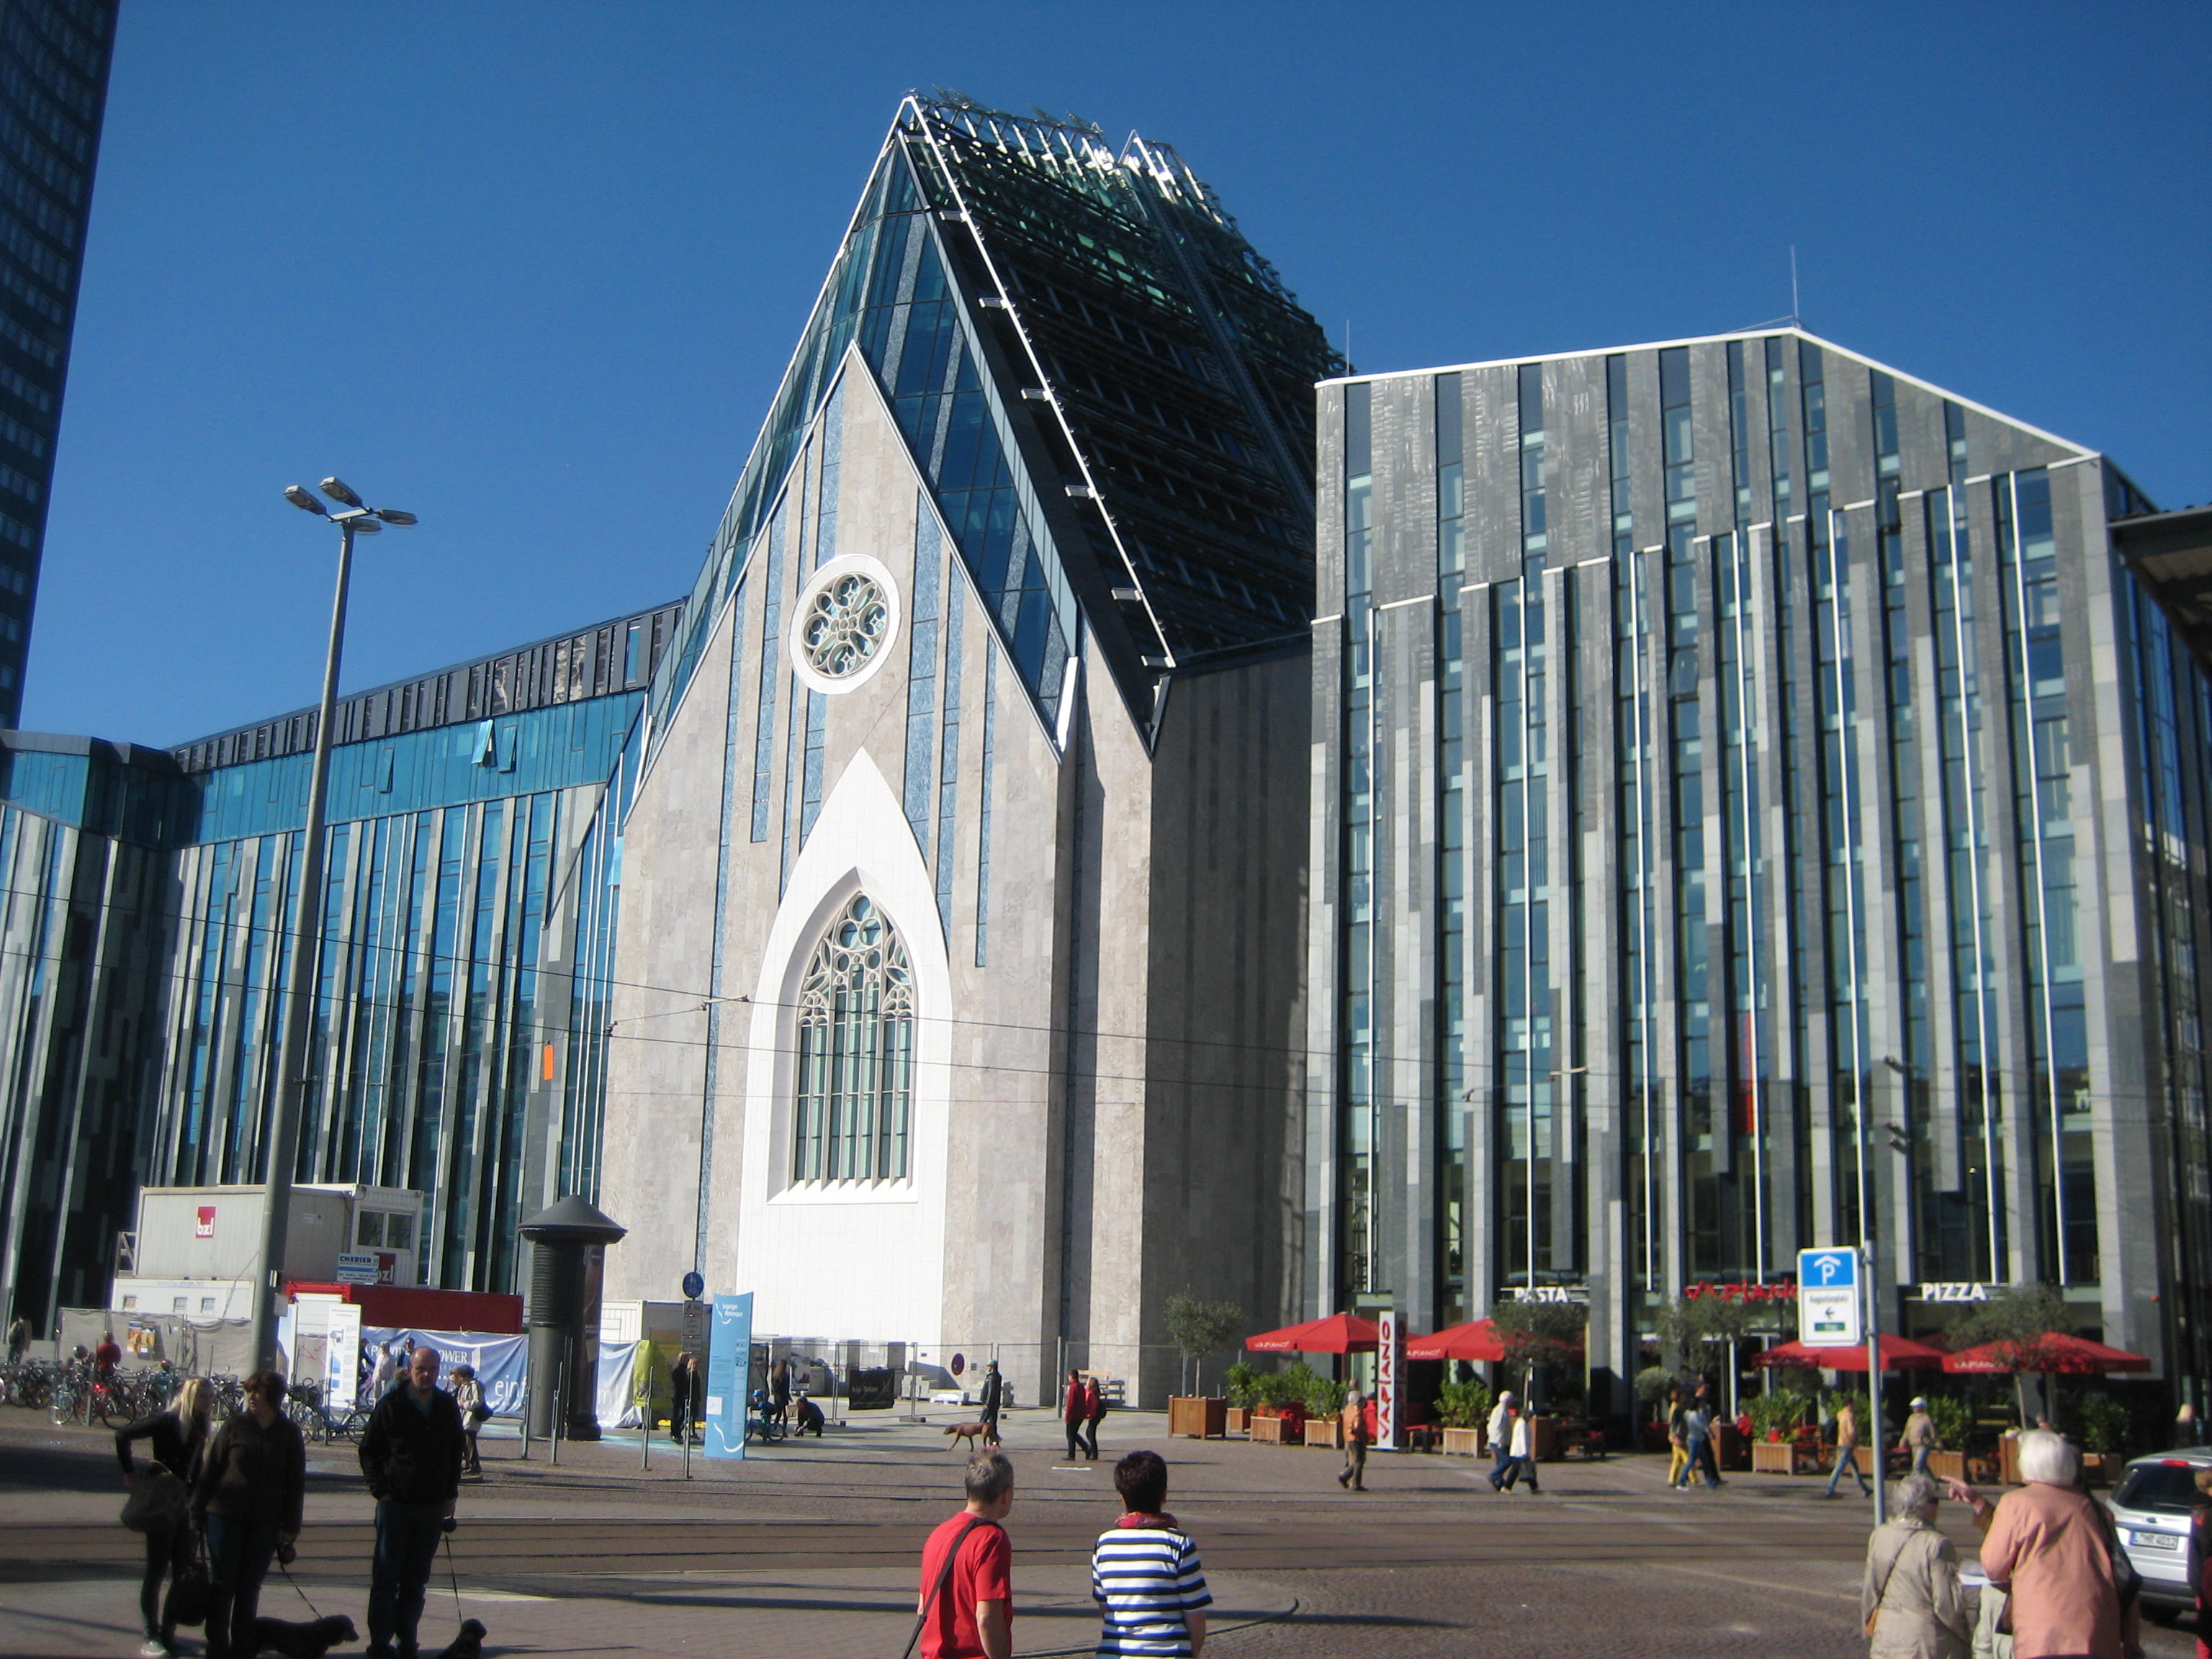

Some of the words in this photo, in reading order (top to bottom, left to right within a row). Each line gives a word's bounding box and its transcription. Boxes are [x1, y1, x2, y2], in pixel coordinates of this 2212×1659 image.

[197, 1217, 214, 1235] bzl
[1821, 1262, 1835, 1285] P
[1922, 1282, 1986, 1301] PIZZA
[1406, 1348, 1441, 1357] APIANO
[1377, 1320, 1392, 1439] VAPIANO
